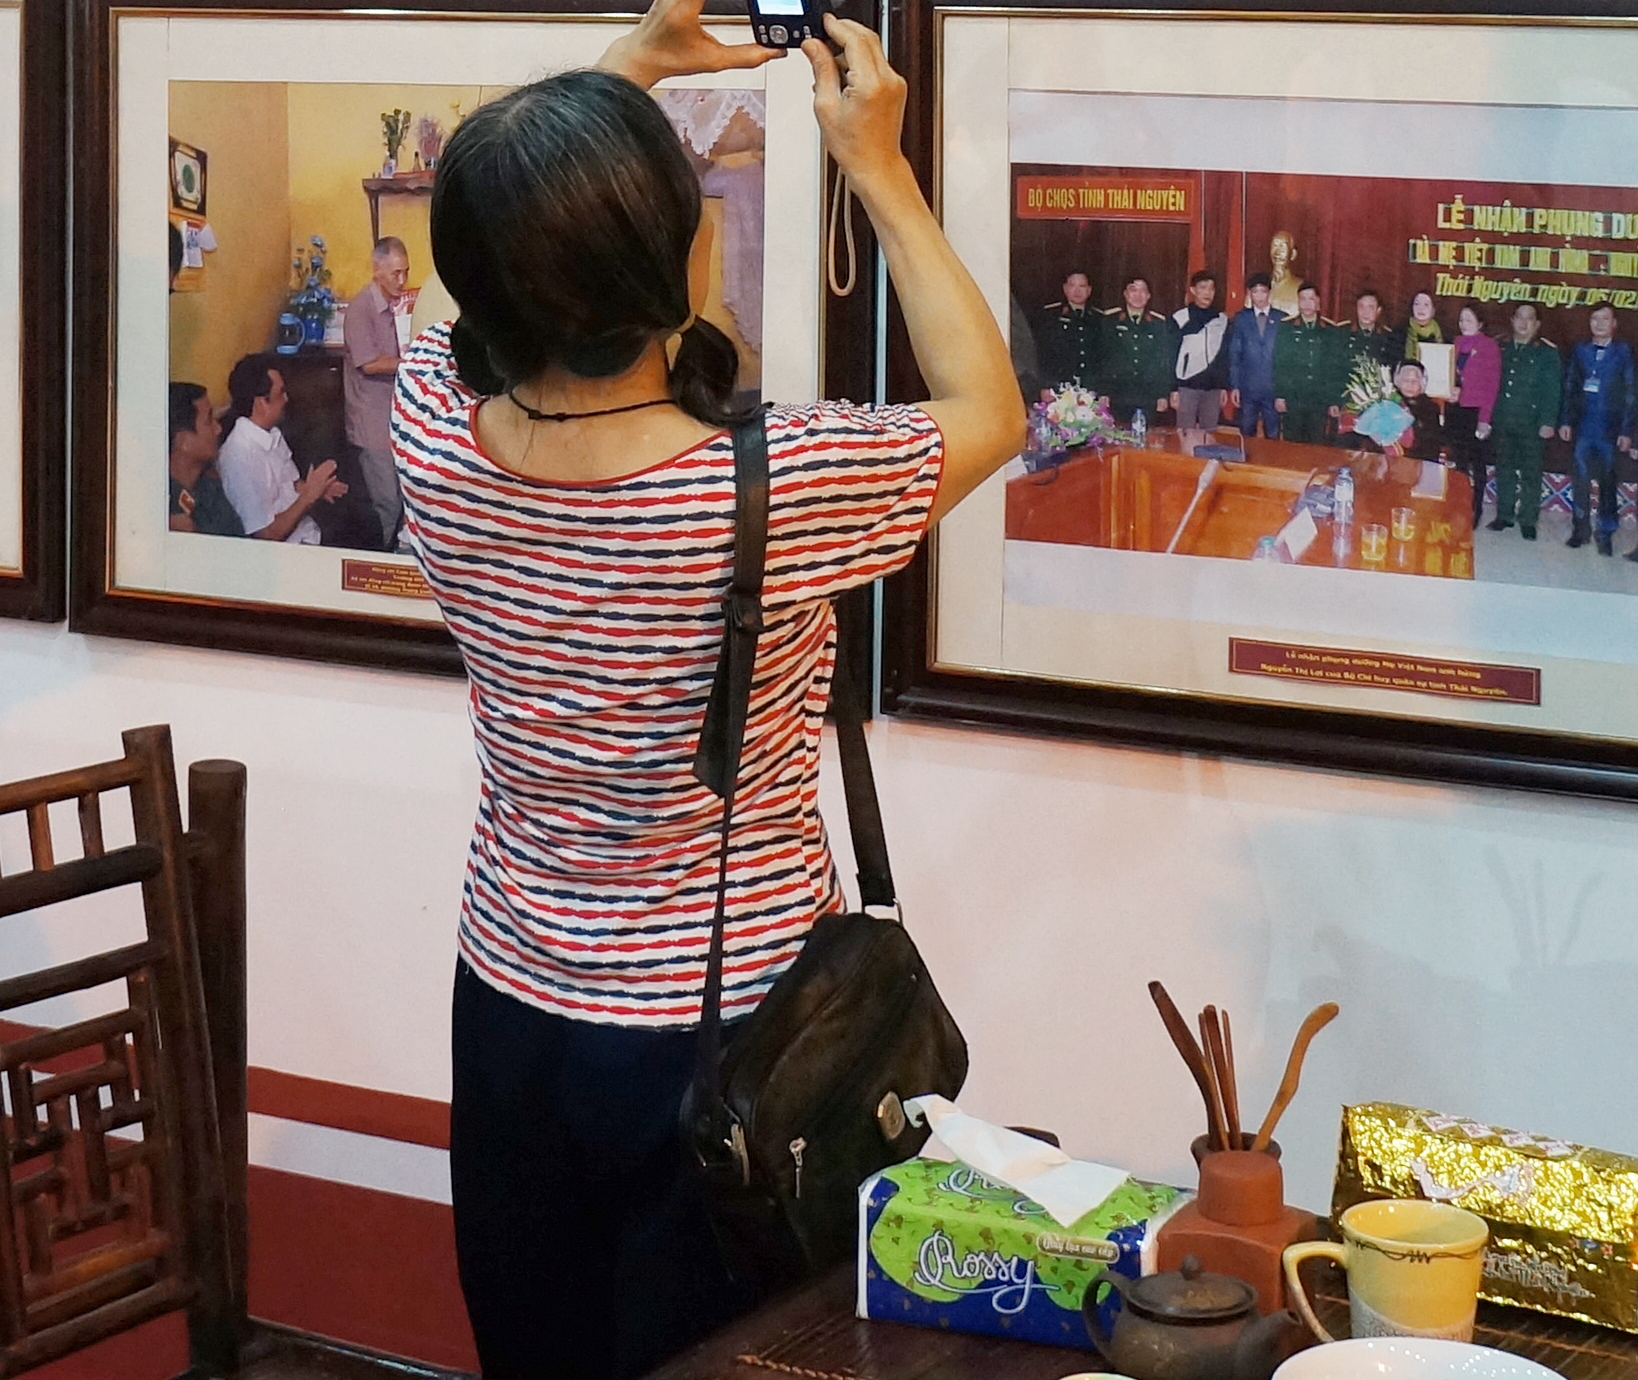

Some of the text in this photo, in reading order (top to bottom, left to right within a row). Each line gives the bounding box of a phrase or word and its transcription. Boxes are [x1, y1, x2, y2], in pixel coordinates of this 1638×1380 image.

[1027, 181, 1186, 212] BỘ CHQS TỈNH THÁI NGUYÊN
[1437, 194, 1465, 230] LỄ
[1473, 199, 1526, 237] NHẬN
[1533, 207, 1604, 240] PHỤNG
[1435, 272, 1470, 296] Thái
[1536, 281, 1582, 309] ngày
[914, 1230, 1060, 1315] Rossy
